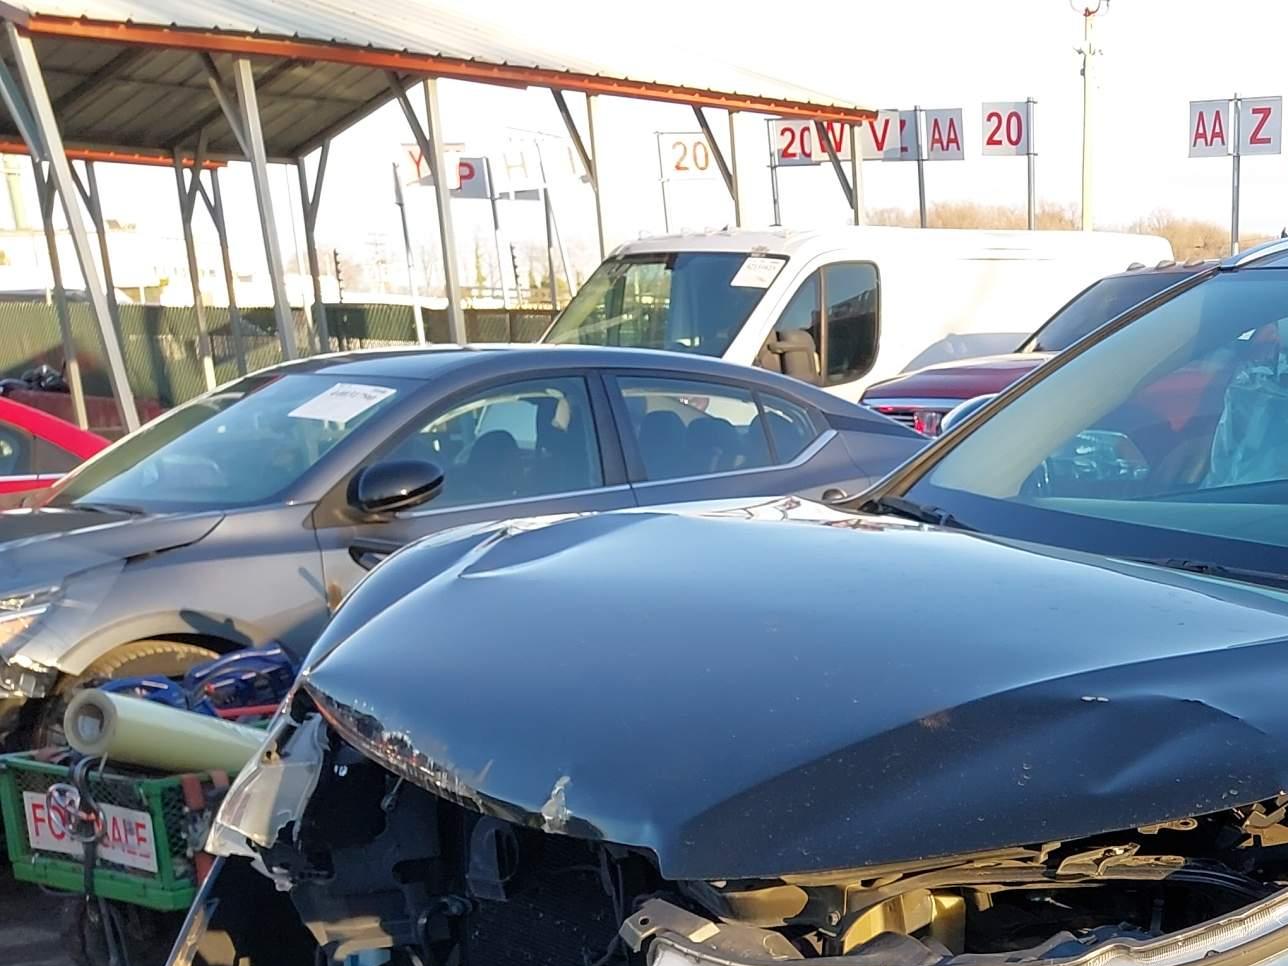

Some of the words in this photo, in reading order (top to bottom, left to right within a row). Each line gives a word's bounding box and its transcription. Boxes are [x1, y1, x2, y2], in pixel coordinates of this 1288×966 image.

[868, 119, 890, 151] V
[930, 118, 960, 151] AA
[986, 111, 1023, 146] 20
[1193, 110, 1226, 147] AA
[1250, 107, 1272, 144] Z
[672, 141, 709, 171] 20
[457, 161, 476, 191] P
